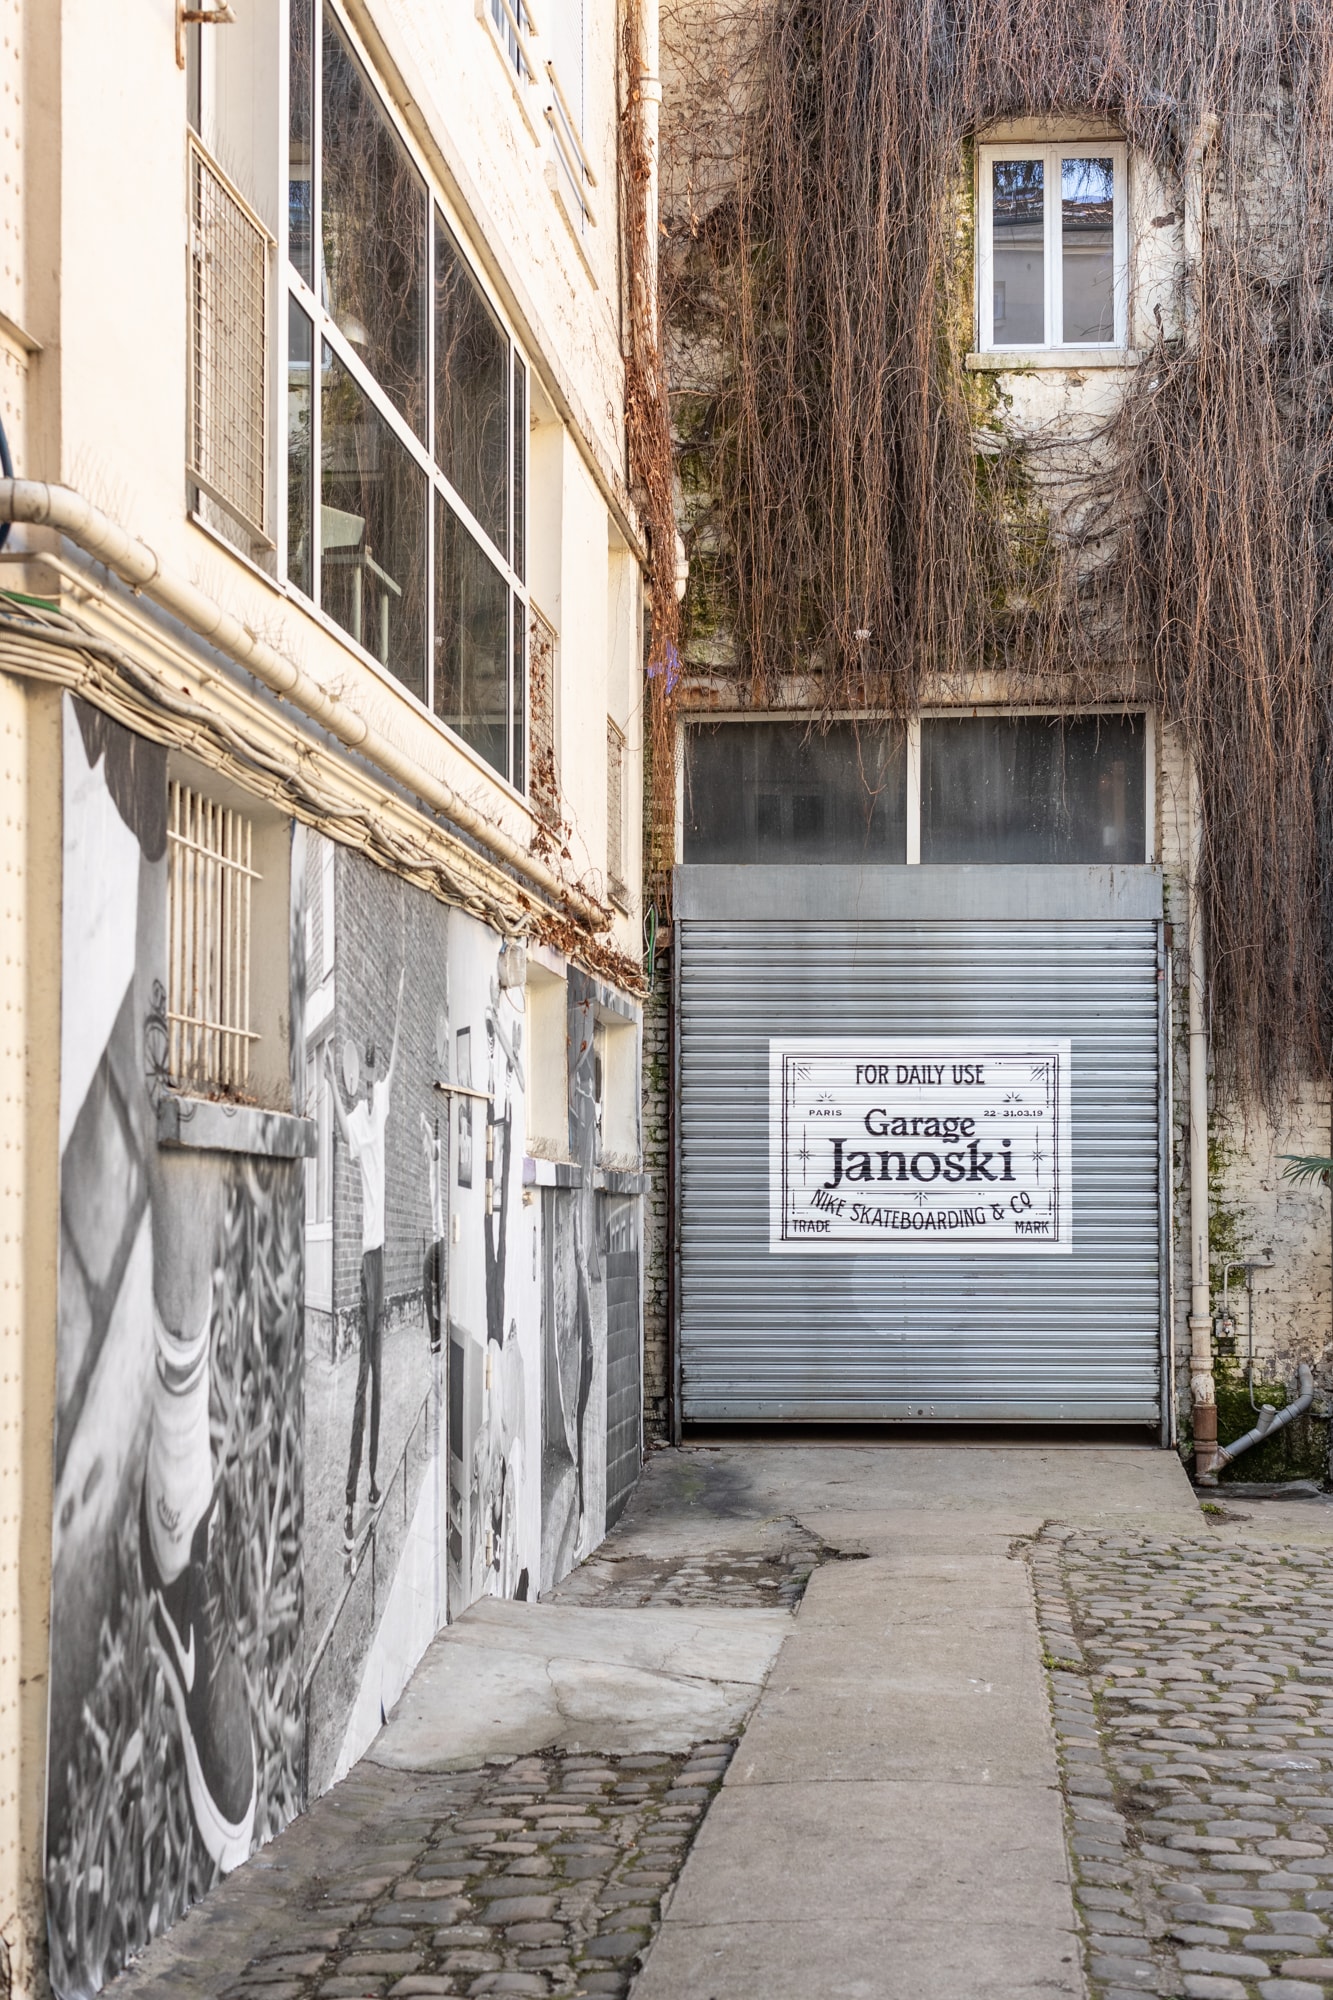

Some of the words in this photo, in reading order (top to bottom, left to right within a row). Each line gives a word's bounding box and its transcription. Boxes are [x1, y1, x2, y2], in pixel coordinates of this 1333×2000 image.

[856, 1064, 888, 1085] FOR
[896, 1064, 945, 1085] DAILY
[952, 1064, 985, 1085] USE
[864, 1108, 975, 1143] Garage
[823, 1138, 1017, 1189] Janoski
[810, 1189, 847, 1217] NIKE
[850, 1203, 986, 1230] SKATEBOARDING
[991, 1203, 1004, 1221] &
[792, 1219, 831, 1233] TRADE
[1015, 1221, 1049, 1234] MARK
